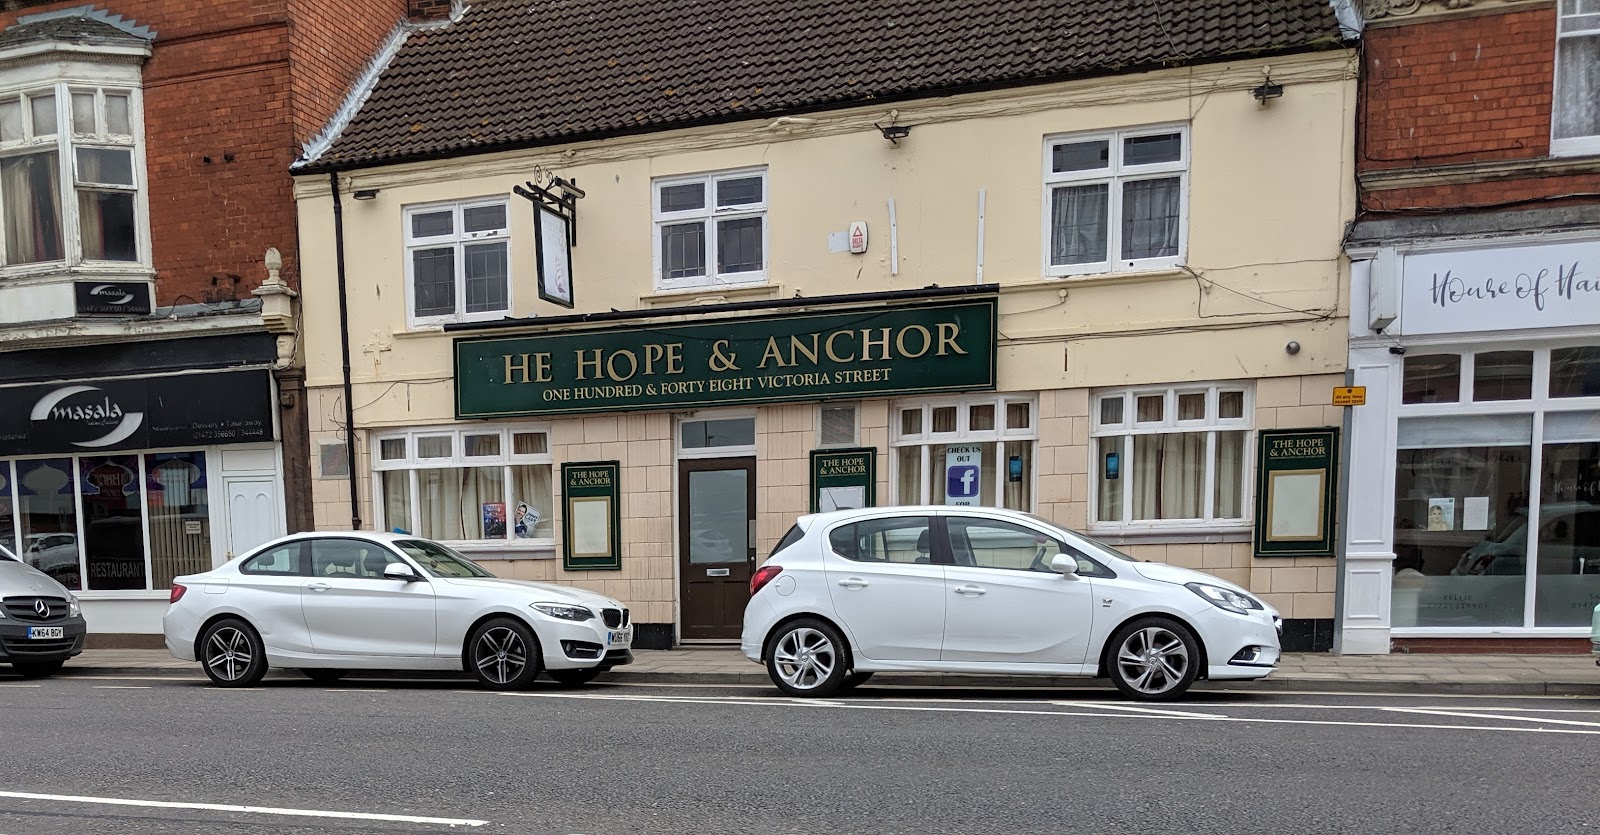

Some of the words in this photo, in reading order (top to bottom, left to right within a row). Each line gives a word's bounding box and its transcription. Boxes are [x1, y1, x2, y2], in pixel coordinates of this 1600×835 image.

[502, 352, 553, 385] HE
[574, 342, 685, 382] HOPE
[708, 339, 741, 372] &
[756, 322, 968, 369] ANCHOR
[542, 388, 571, 402] ONE
[574, 384, 643, 400] HUNDRED
[645, 383, 658, 396] &
[660, 380, 705, 395] FORTY
[709, 377, 754, 392] EIGHT
[757, 371, 831, 389] VICTORIA
[834, 368, 892, 384] STREET
[52, 396, 122, 420] masala
[1272, 440, 1294, 448] THE
[1296, 438, 1324, 447] HOPE
[947, 446, 970, 454] CHECK
[1269, 448, 1279, 457] &
[1281, 447, 1326, 456] ANCHOR
[822, 459, 840, 467] THE
[841, 457, 864, 466] HOPE
[956, 455, 970, 463] OUT
[572, 471, 588, 479] THE
[588, 470, 609, 478] HOPE
[819, 467, 827, 475] &
[829, 465, 866, 474] ANCHOR
[578, 477, 611, 485] ANCHOR
[90, 562, 144, 578] RESTAURANT
[32, 628, 50, 638] KW64
